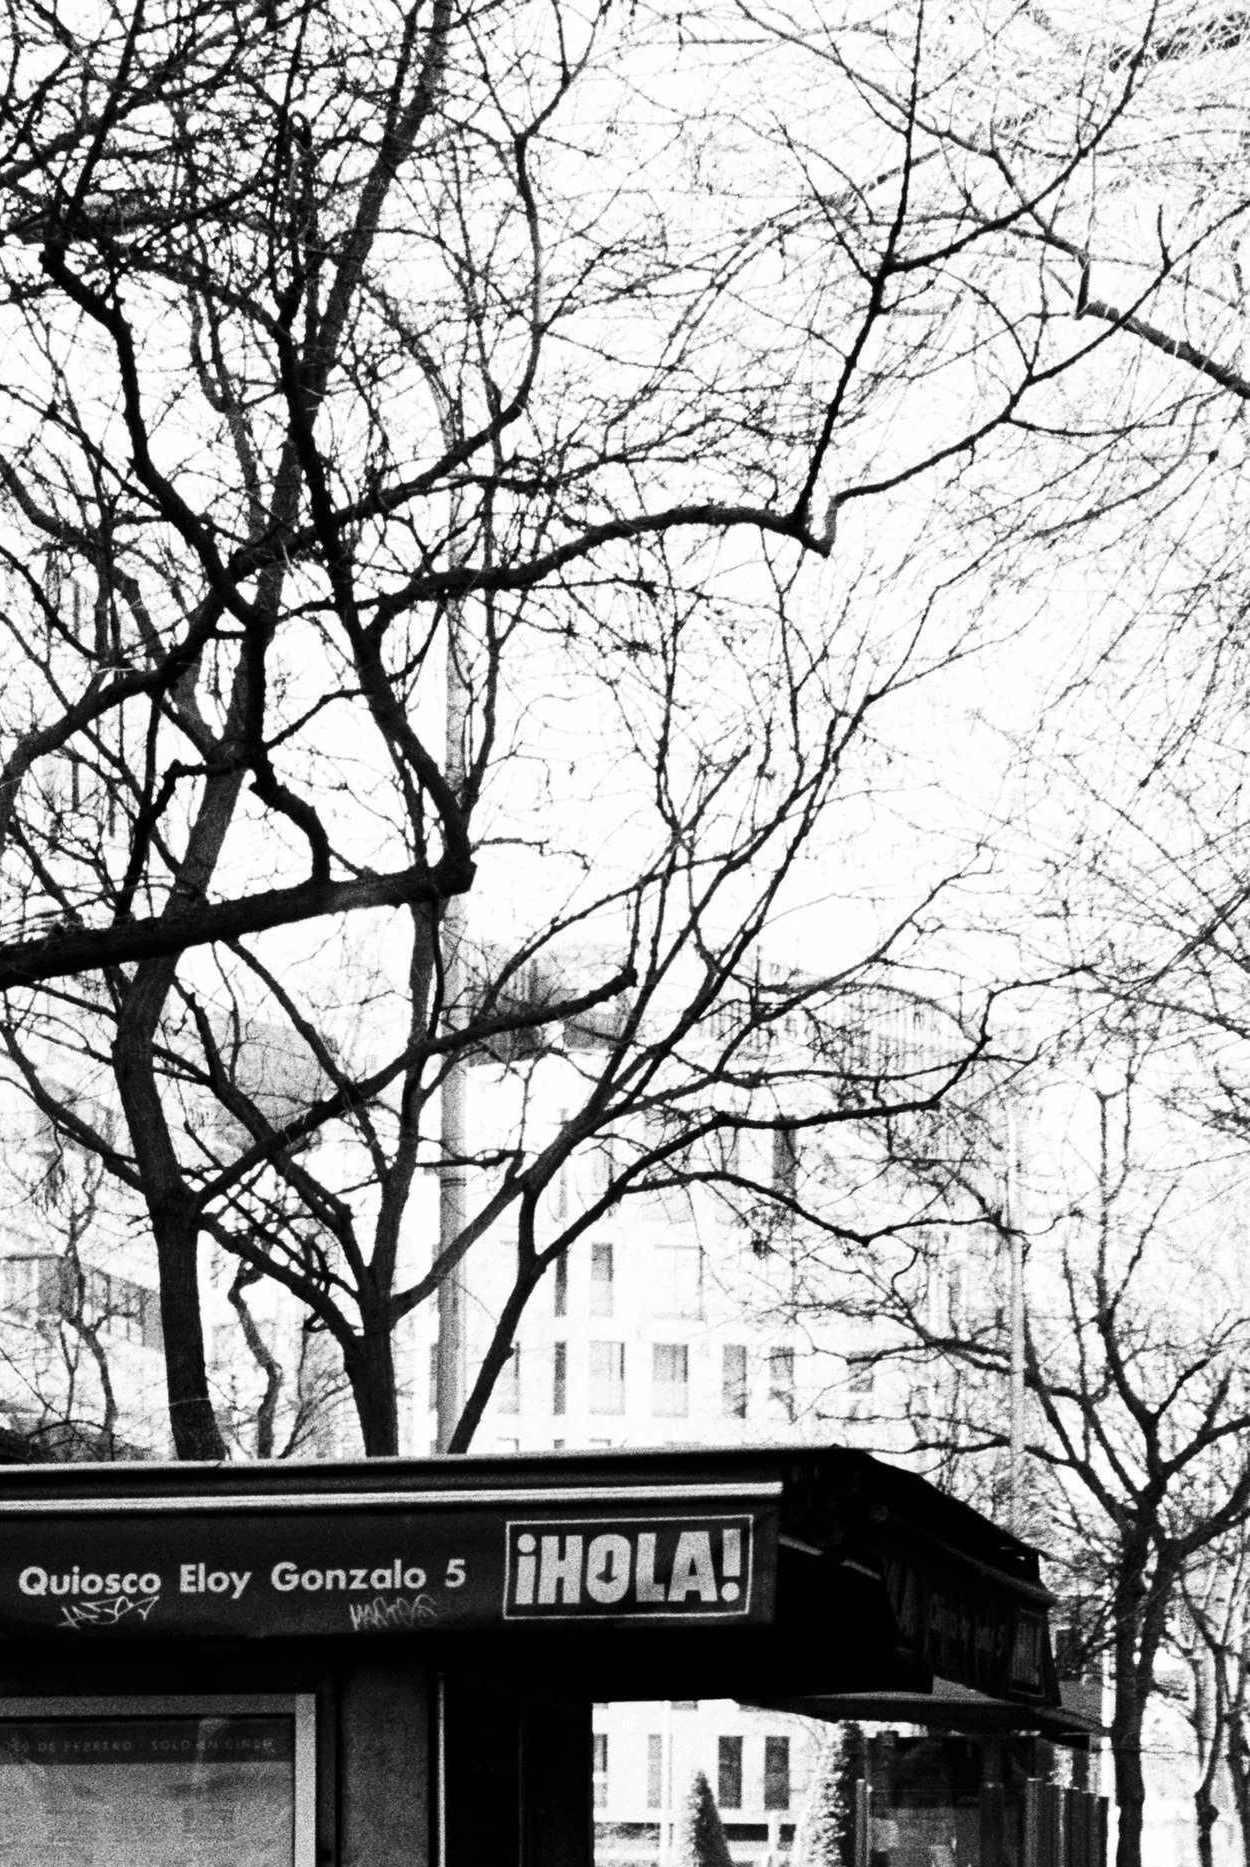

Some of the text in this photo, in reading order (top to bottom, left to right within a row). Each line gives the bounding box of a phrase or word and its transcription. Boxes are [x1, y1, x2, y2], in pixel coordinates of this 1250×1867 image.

[18, 1558, 466, 1599] Quiosco Eloy Gonzalo 5
[516, 1528, 741, 1604] ¡HOLA!
[38, 1740, 56, 1753] DE
[64, 1740, 133, 1753] FEBRERO
[150, 1738, 191, 1751] SOLO
